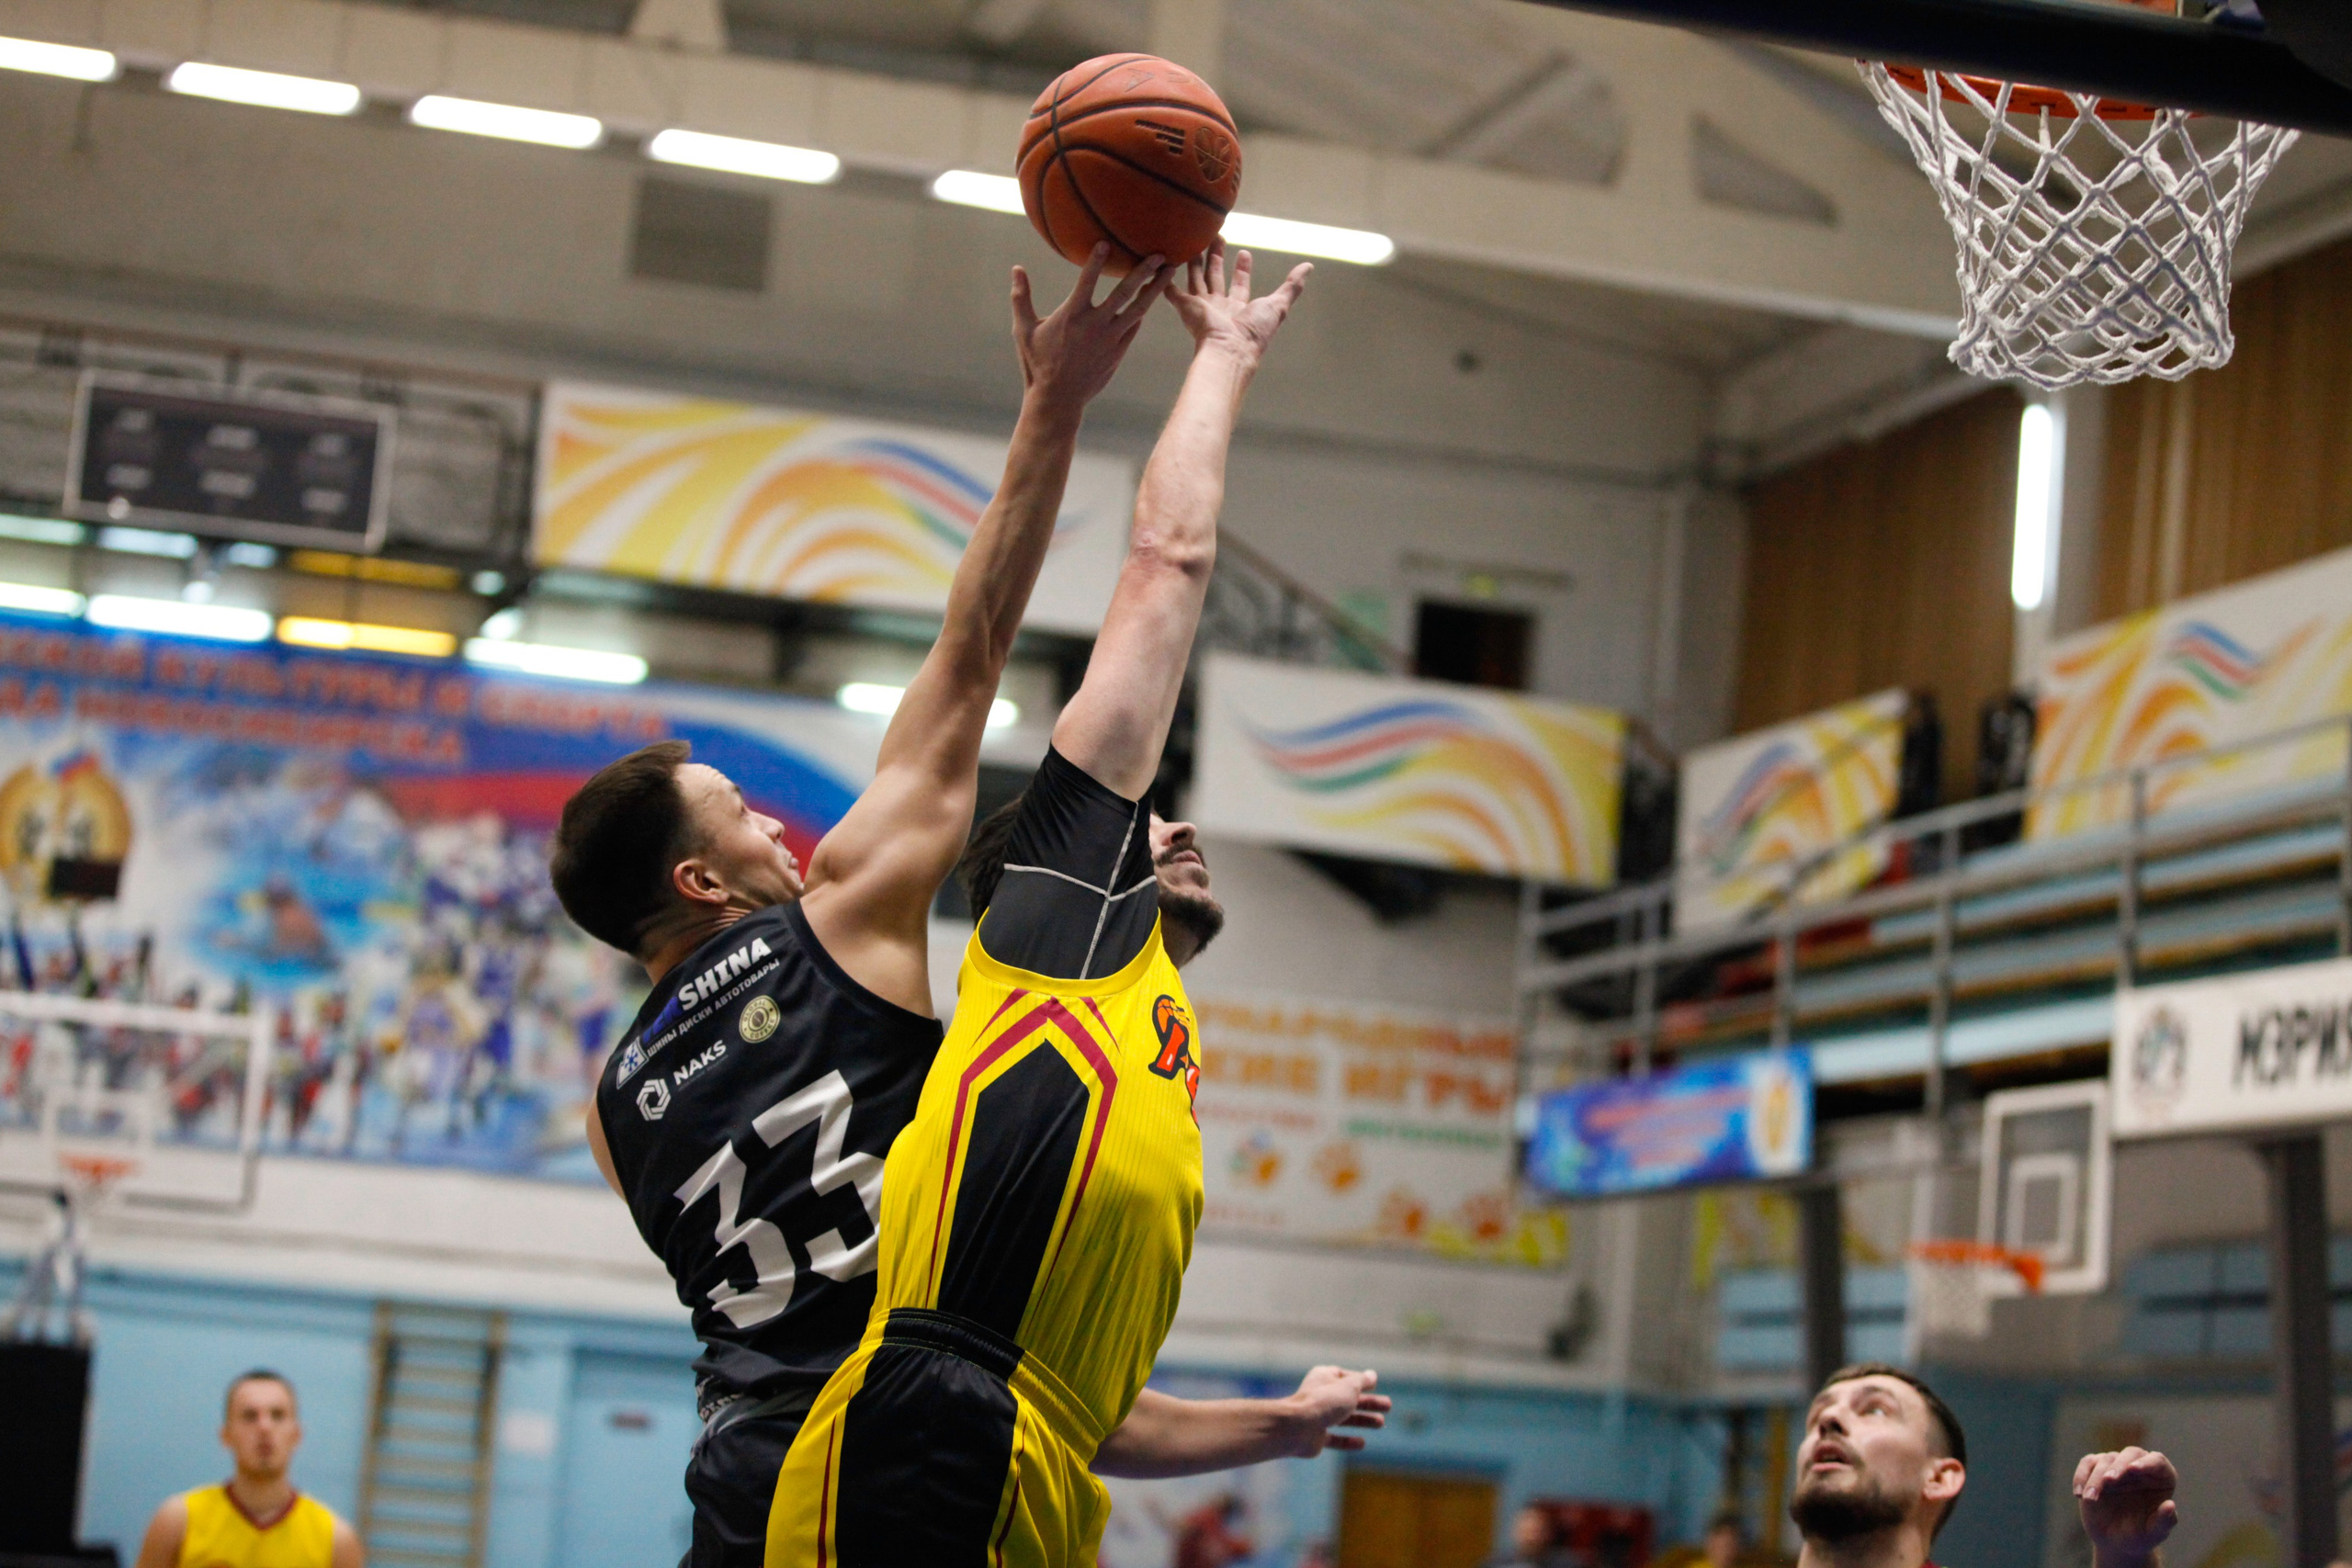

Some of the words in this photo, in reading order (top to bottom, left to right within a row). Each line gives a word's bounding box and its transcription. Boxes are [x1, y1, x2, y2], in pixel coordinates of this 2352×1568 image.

[646, 1028, 678, 1058] ШИНЫ
[678, 1005, 714, 1036] ДИСКИ
[714, 958, 780, 1010] АВТОТОВАРЫ
[673, 1039, 727, 1086] NAKS
[673, 1069, 888, 1329] 33
